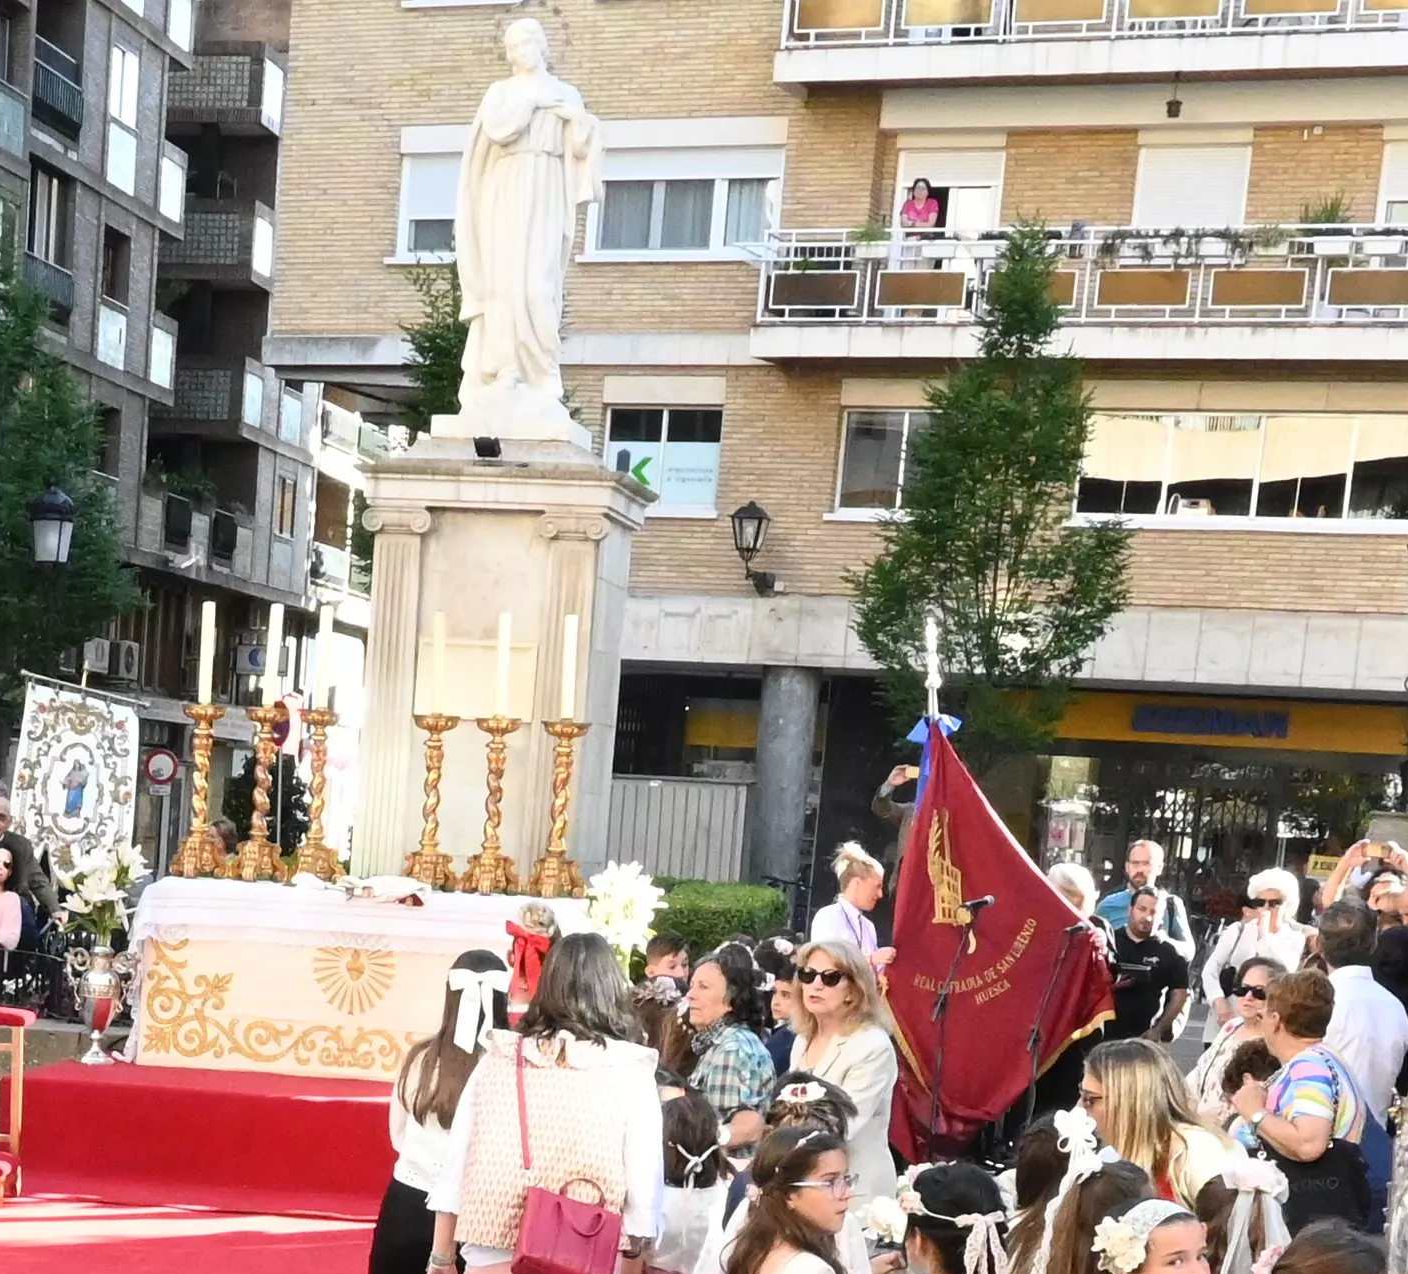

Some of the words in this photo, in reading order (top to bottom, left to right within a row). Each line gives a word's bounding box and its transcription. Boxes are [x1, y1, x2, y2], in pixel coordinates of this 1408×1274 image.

[913, 973, 936, 991] REAL
[937, 974, 983, 994] CFRADIA
[983, 967, 998, 983] DE
[996, 950, 1015, 974] SAN
[974, 979, 1011, 1004] HUESCA
